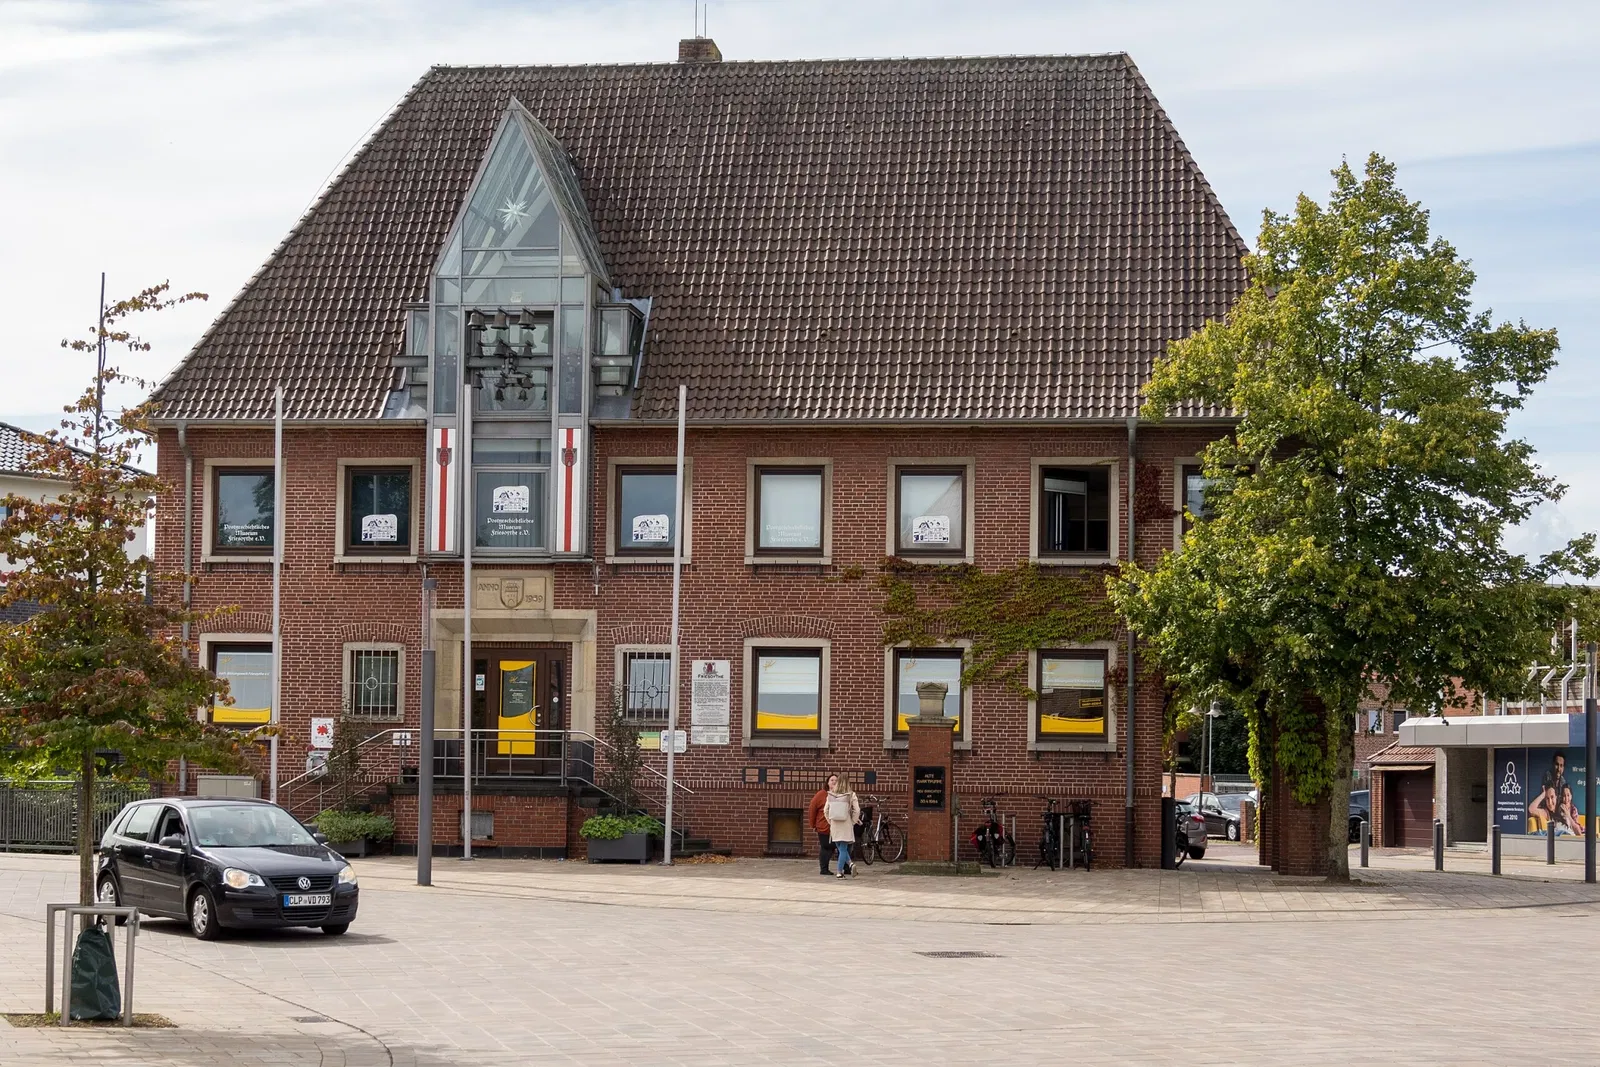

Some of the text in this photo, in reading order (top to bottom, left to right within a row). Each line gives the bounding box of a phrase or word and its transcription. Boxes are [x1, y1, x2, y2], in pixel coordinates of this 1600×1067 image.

[478, 583, 500, 592] ANNO
[290, 896, 302, 905] CLP
[317, 895, 331, 904] 793
